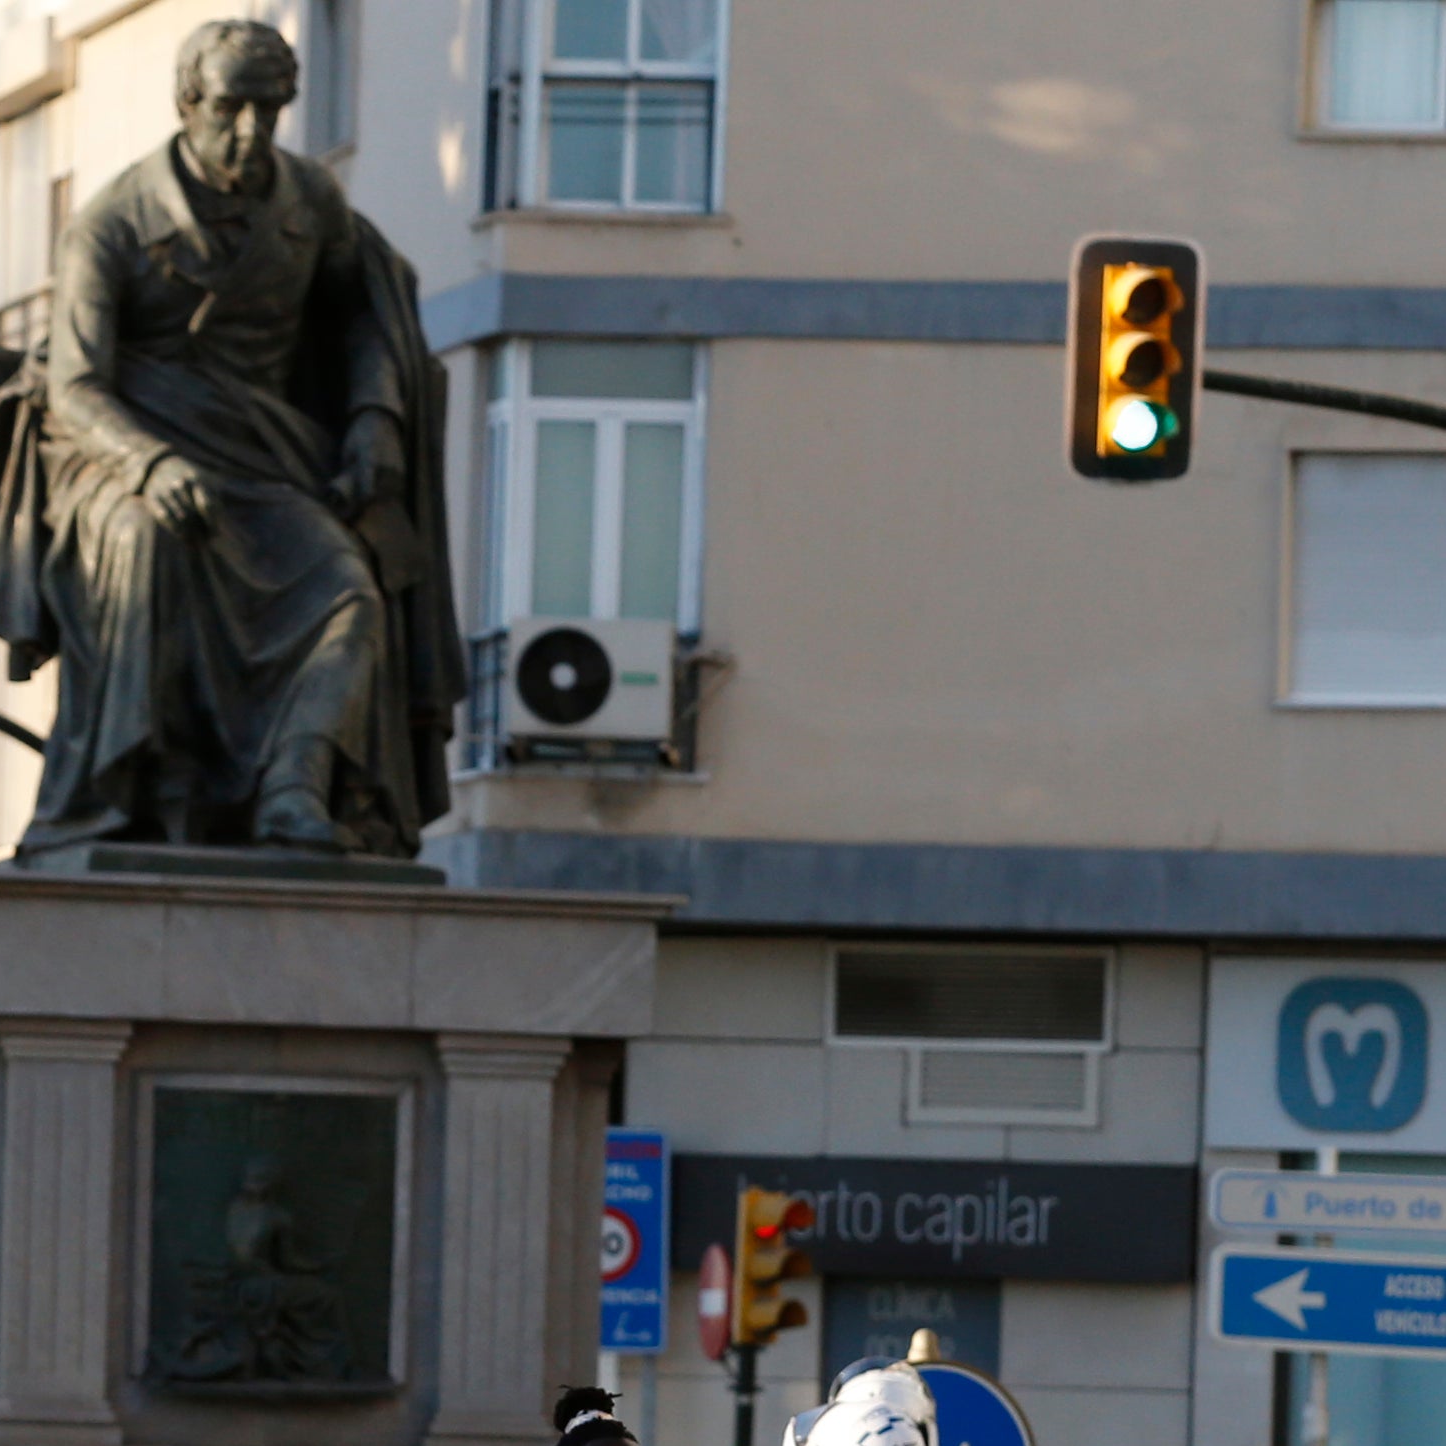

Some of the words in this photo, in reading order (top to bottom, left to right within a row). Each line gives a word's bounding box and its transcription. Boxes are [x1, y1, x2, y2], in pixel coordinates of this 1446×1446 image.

[894, 1176, 1058, 1262] capilar
[1304, 1191, 1396, 1219] Puerto
[1409, 1194, 1442, 1220] de
[1384, 1273, 1444, 1300] ACCESO
